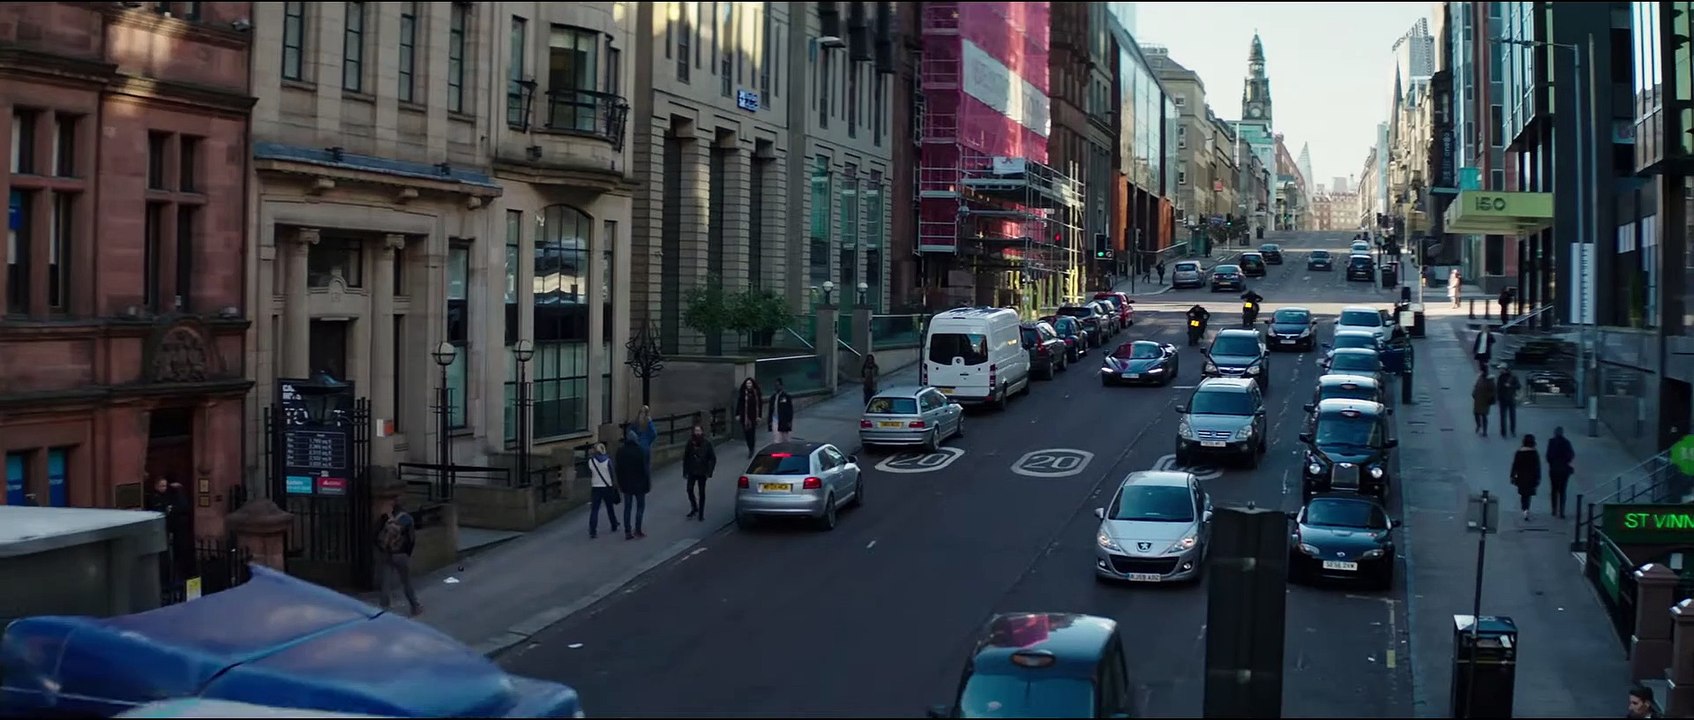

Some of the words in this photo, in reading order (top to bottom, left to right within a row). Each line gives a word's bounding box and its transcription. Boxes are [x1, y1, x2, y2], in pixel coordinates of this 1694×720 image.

[888, 453, 949, 467] 20
[1023, 455, 1082, 470] 20
[1624, 513, 1650, 529] ST
